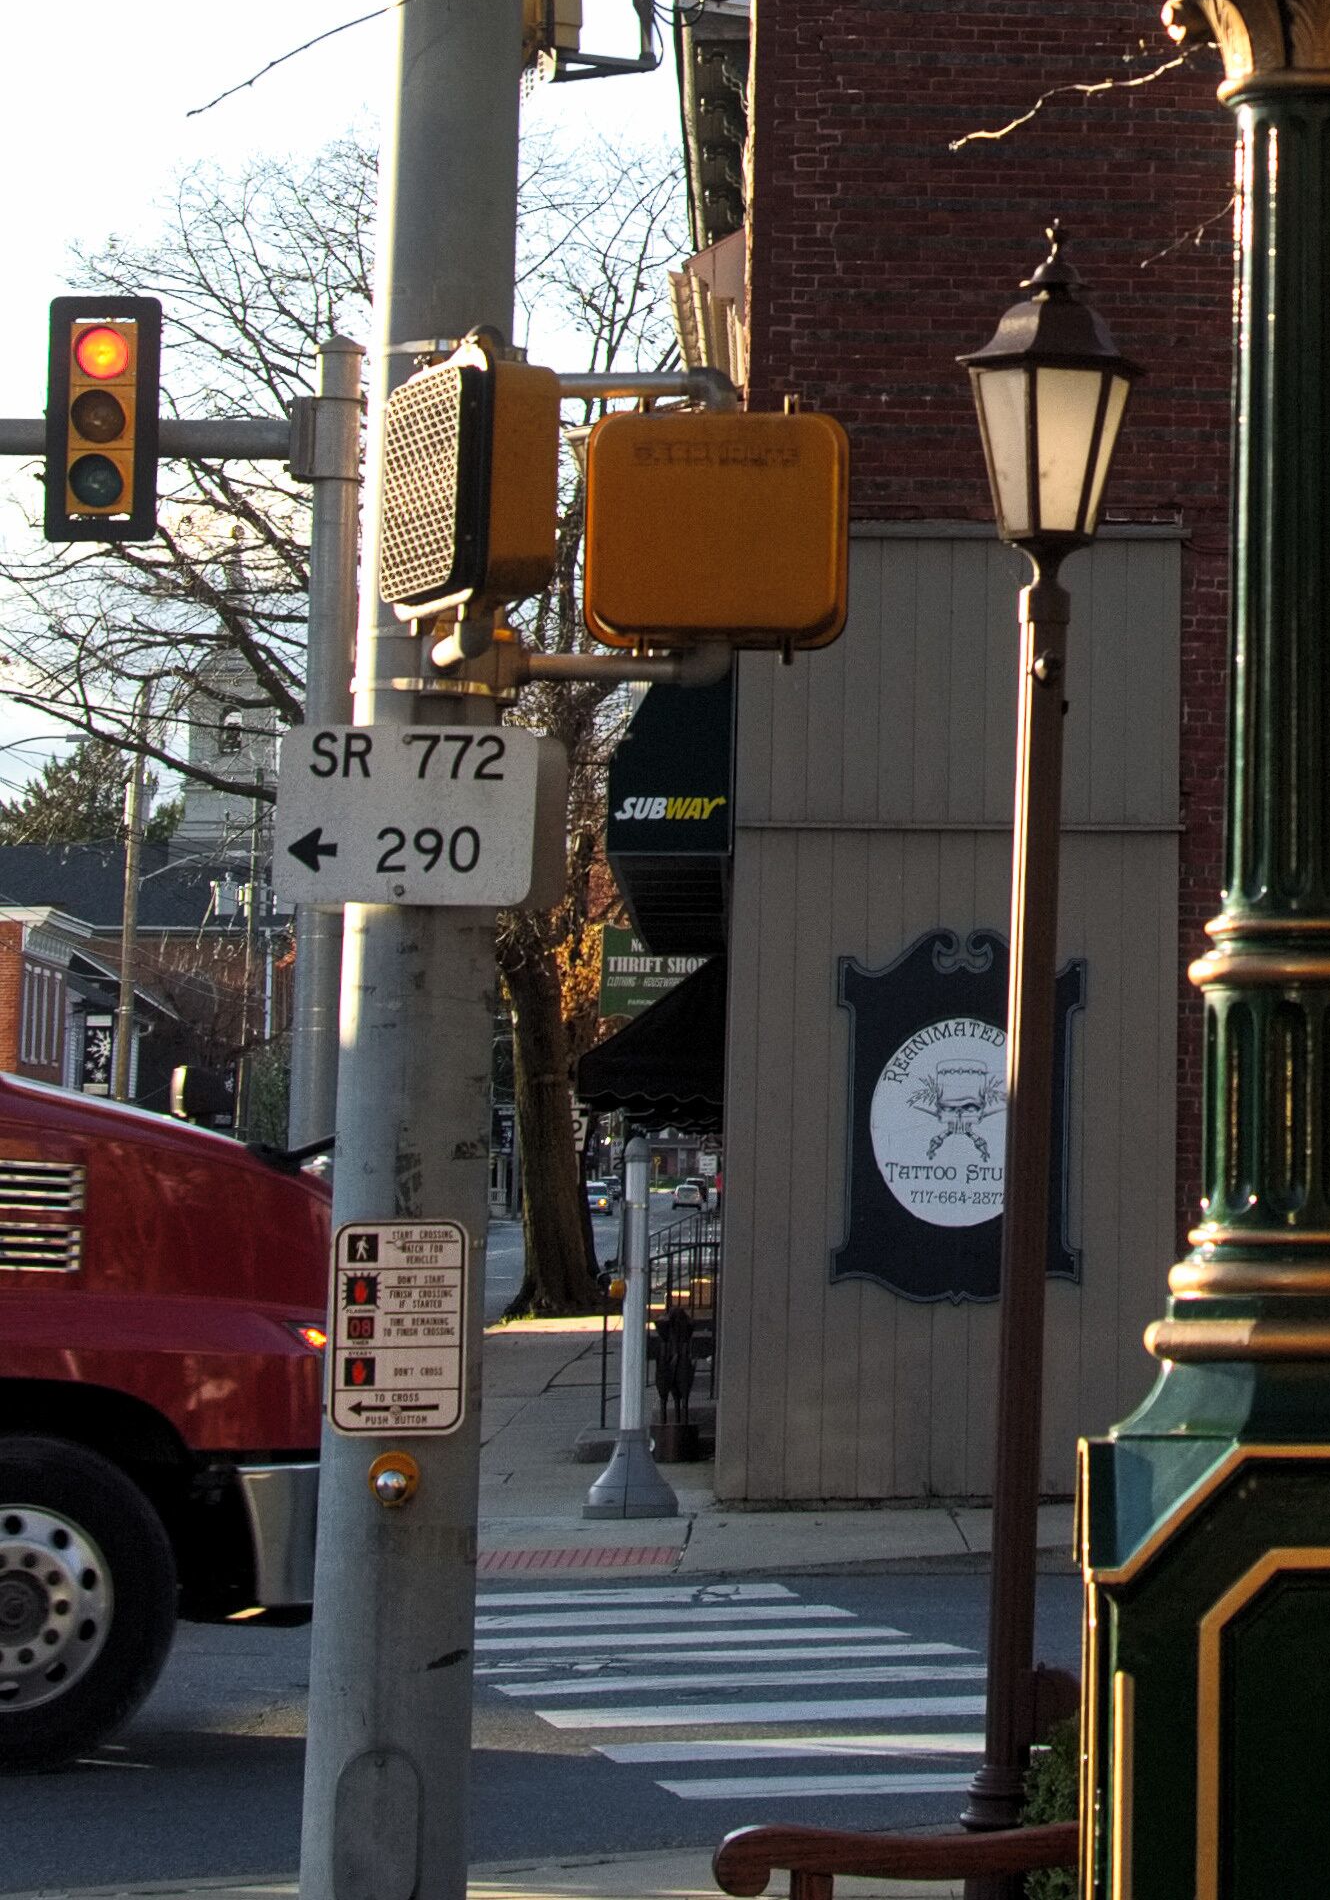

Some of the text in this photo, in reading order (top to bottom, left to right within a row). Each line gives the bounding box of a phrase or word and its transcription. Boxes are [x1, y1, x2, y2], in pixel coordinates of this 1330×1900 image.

[309, 731, 506, 781] SR 772
[614, 796, 727, 821] SUBWAY
[376, 826, 481, 874] 290
[606, 956, 664, 973] THRIFT
[883, 1021, 1006, 1084] REANIMATED
[885, 1162, 1004, 1184] TATTOO STU
[392, 1230, 454, 1240] START CROSSING
[429, 1244, 444, 1253] FOR
[405, 1255, 439, 1265] VEHICLES
[397, 1275, 445, 1285] DON'T START
[389, 1289, 453, 1300] FINISH CROSSING
[398, 1300, 443, 1309] IF STARTED
[390, 1317, 449, 1327] TIME REMAINING
[383, 1327, 455, 1338] TO FINISH CROSSING
[393, 1367, 443, 1378] DON'T CROSS
[374, 1392, 420, 1403] TO CROSS
[365, 1415, 428, 1426] PUSH BUTTON
